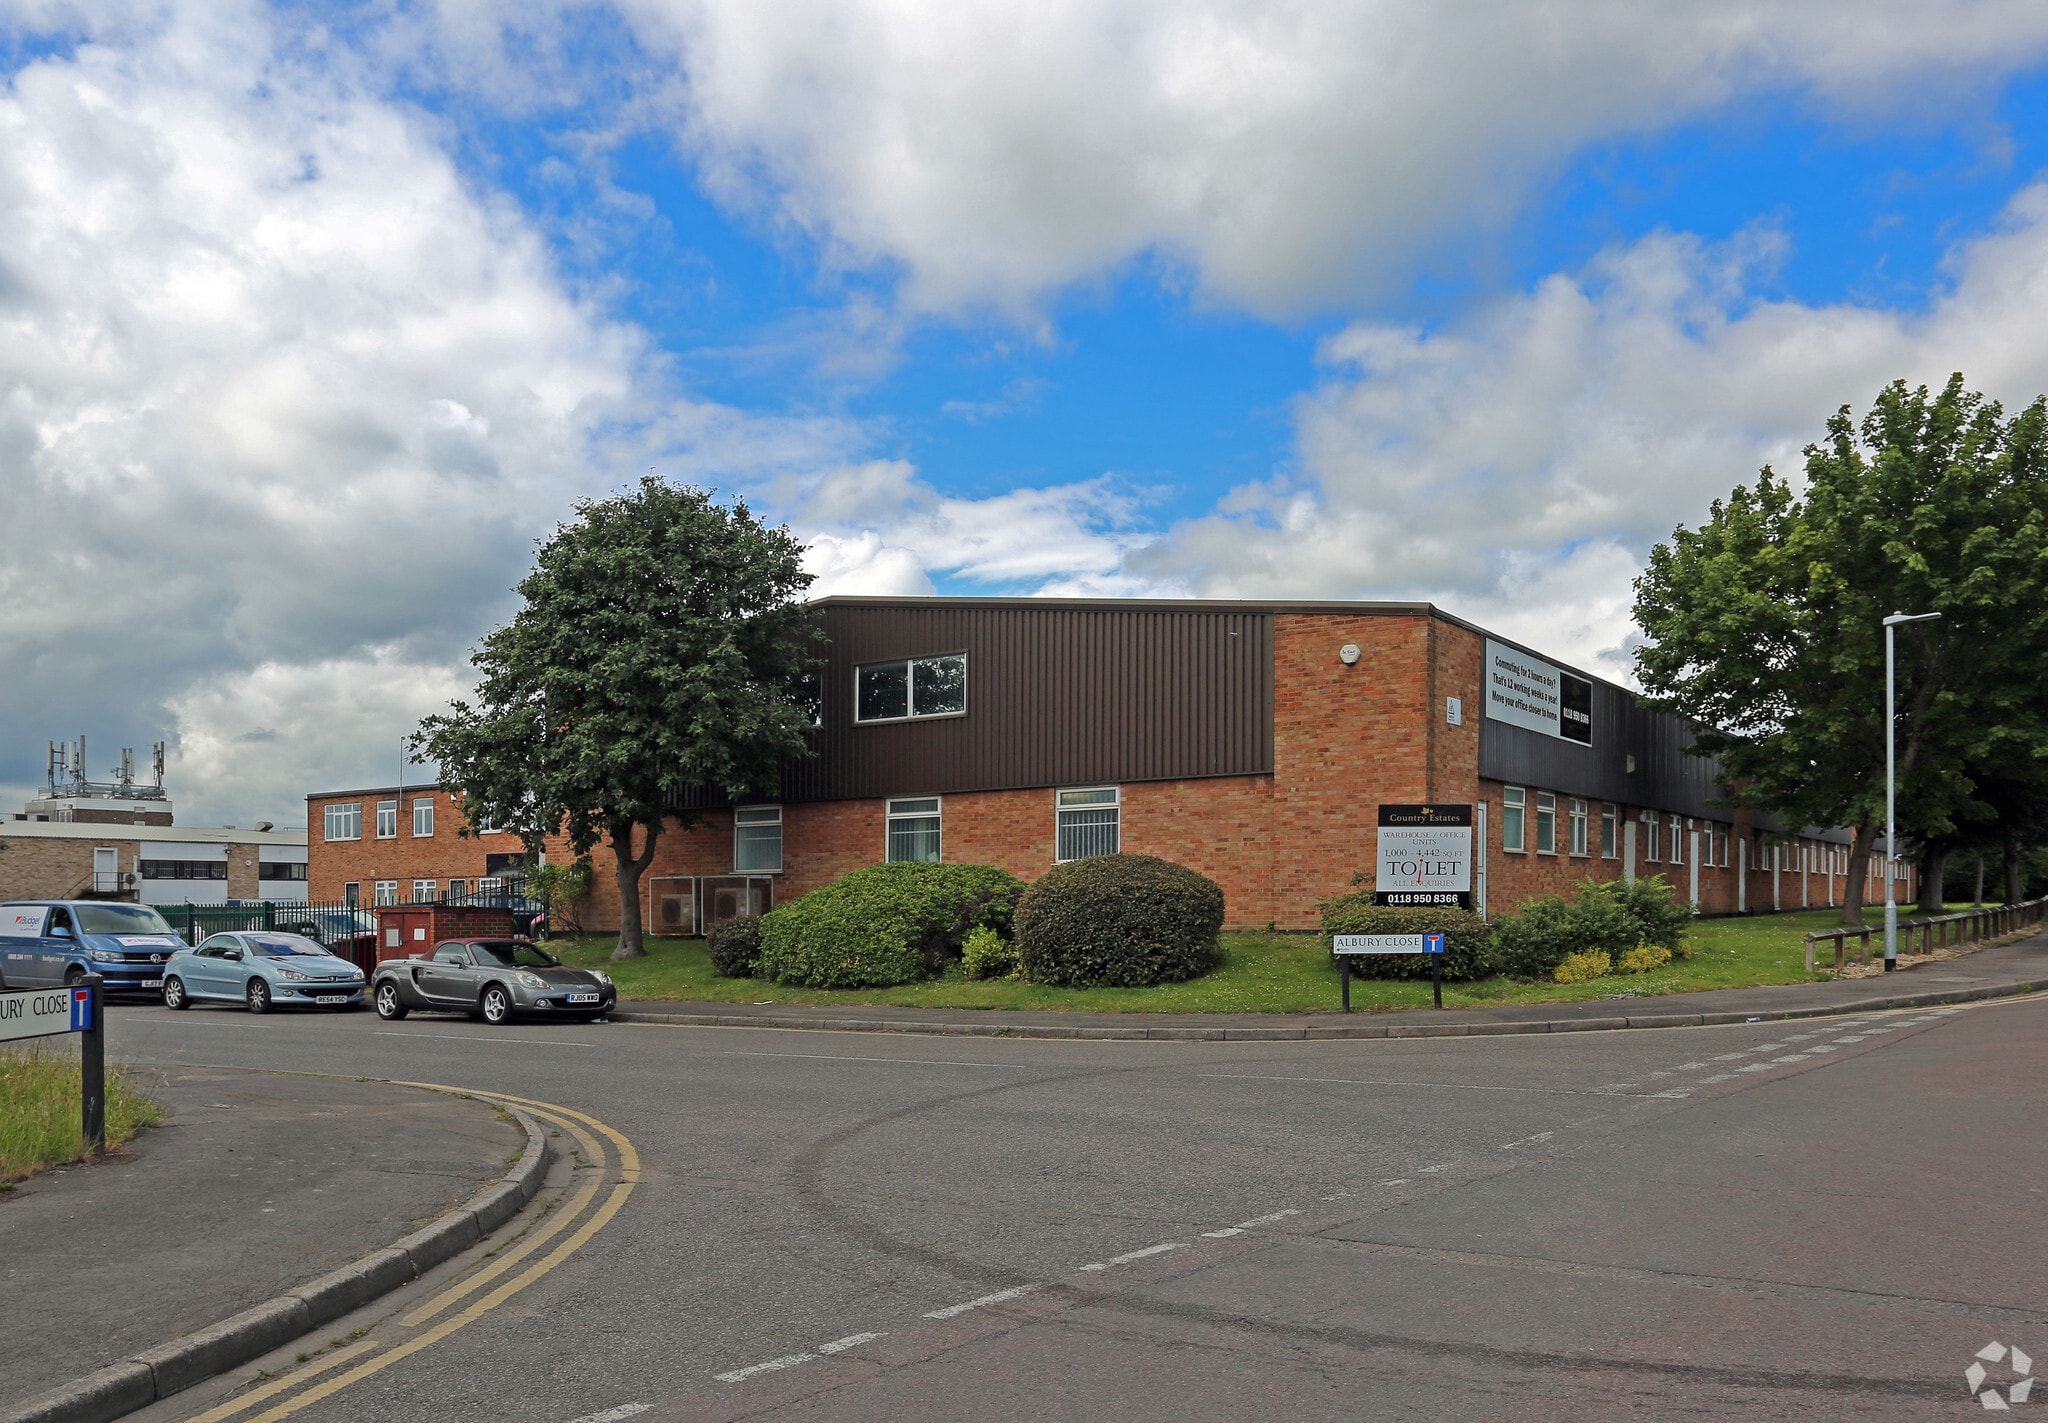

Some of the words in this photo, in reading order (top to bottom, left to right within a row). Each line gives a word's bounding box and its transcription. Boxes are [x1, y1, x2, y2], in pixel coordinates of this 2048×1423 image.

[1495, 656, 1520, 676] Commuting
[1531, 670, 1543, 684] hours
[1547, 677, 1556, 689] day?
[1493, 672, 1507, 686] That's
[1508, 678, 1513, 689] 12
[1514, 682, 1530, 697] working
[1531, 688, 1544, 700] weeks
[1492, 690, 1505, 703] Move
[1505, 697, 1515, 707] your
[1515, 699, 1528, 712] office
[1529, 703, 1541, 715] closer
[1542, 707, 1547, 717] to
[1547, 709, 1557, 721] home
[1389, 814, 1426, 824] Country
[1430, 814, 1460, 822] Estates
[1385, 849, 1407, 857] 1,000
[1416, 849, 1440, 857] 4,442
[1386, 861, 1417, 876] TO
[1424, 861, 1461, 876] LET
[1410, 880, 1455, 888] ENQUIRIES
[1388, 894, 1411, 903] 0118
[1413, 894, 1432, 903] 950
[1434, 894, 1458, 903] 8366
[22, 916, 40, 927] Budget
[1337, 938, 1382, 946] ALBURY
[1384, 938, 1420, 946] CLOSE
[0, 998, 25, 1020] URY
[33, 994, 67, 1016] CLOSE
